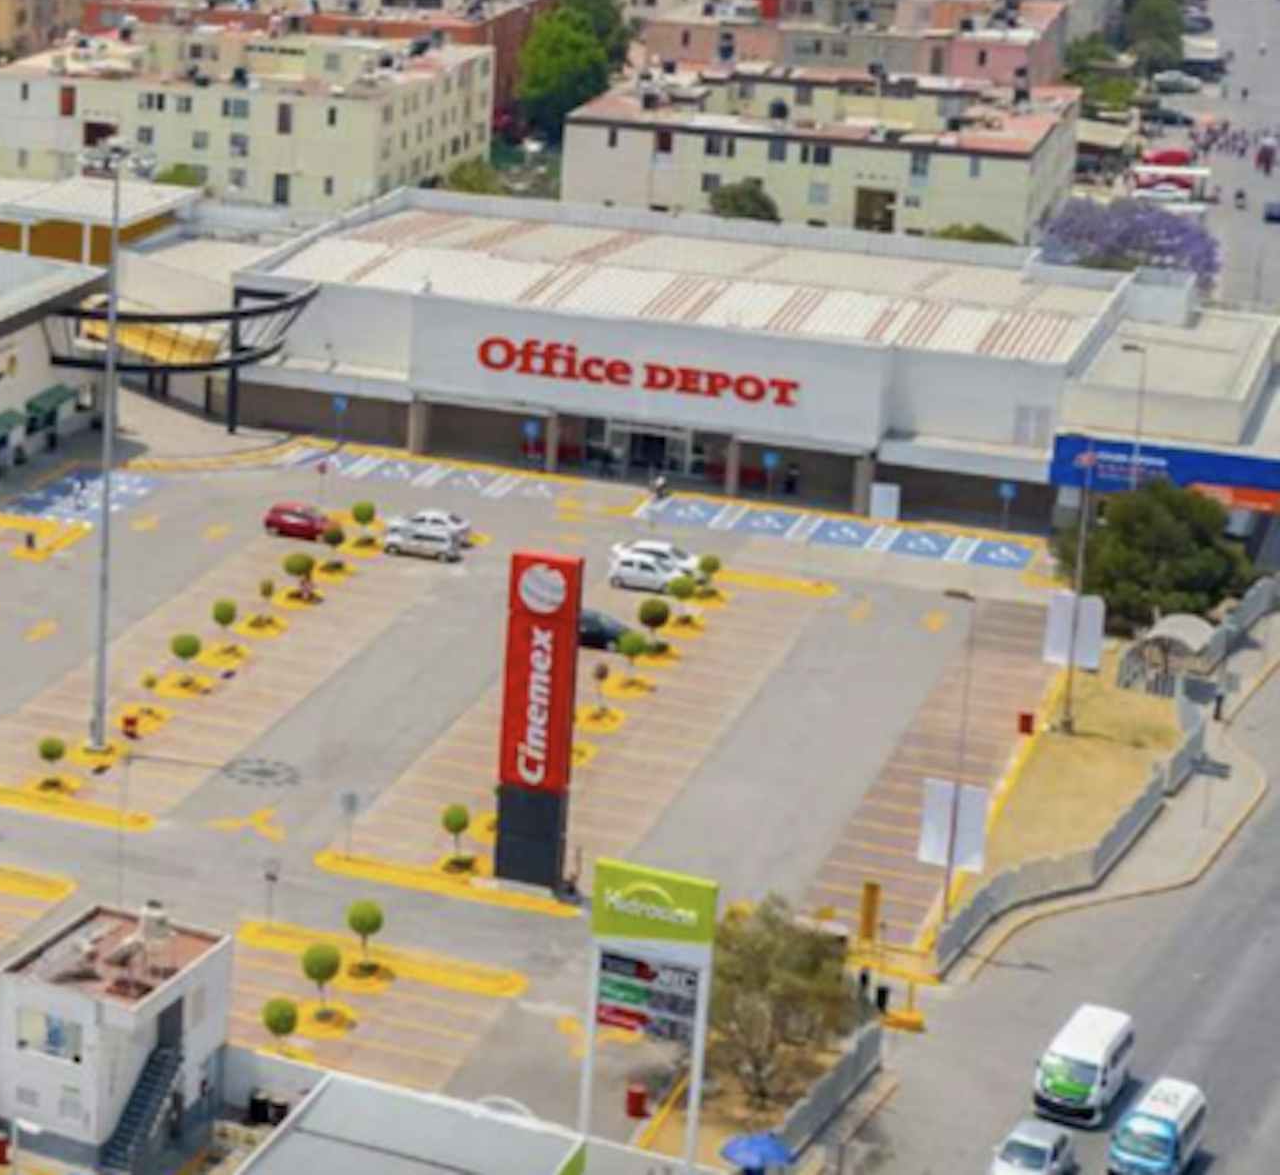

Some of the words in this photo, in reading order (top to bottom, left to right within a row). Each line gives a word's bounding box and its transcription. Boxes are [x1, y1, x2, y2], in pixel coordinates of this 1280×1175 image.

[478, 337, 632, 385] Office
[642, 363, 799, 407] DEPOT
[516, 626, 554, 786] Cinemex
